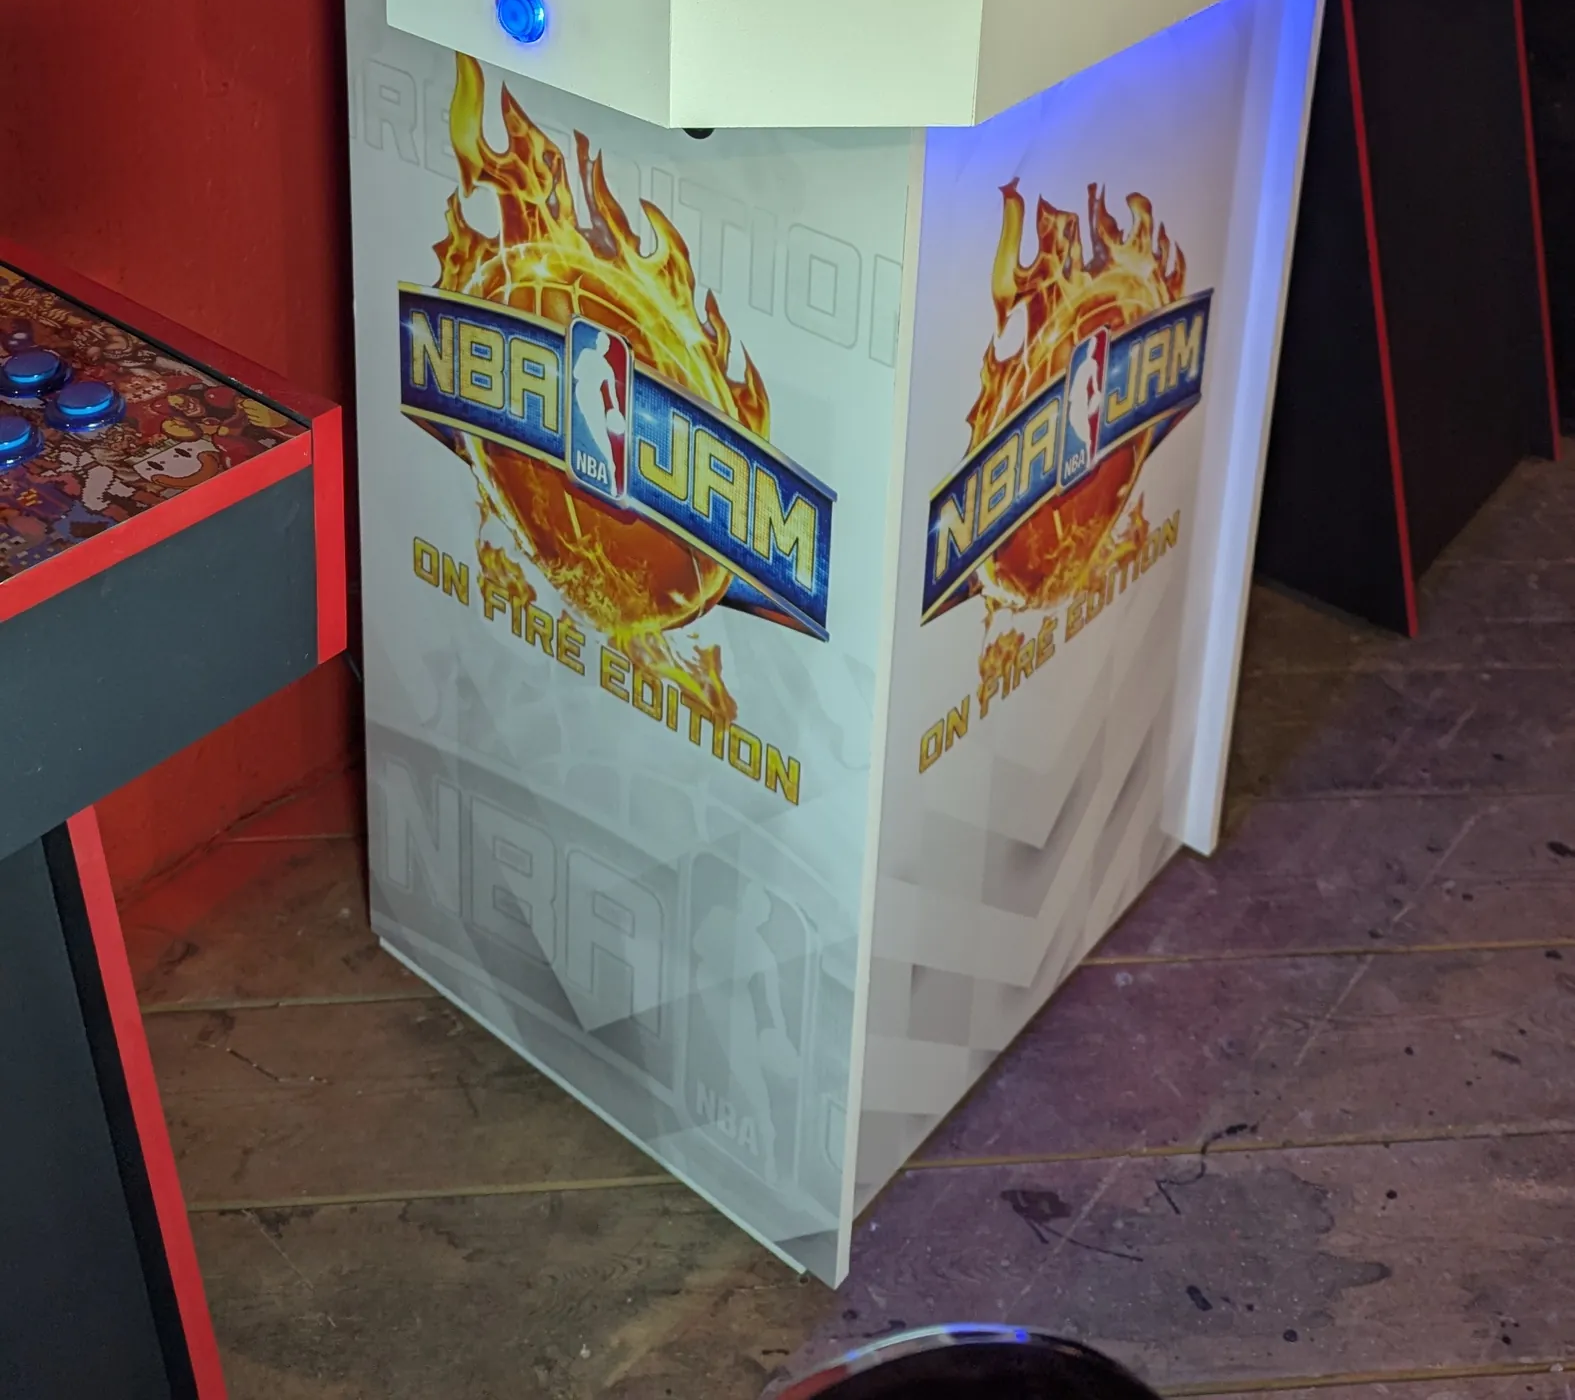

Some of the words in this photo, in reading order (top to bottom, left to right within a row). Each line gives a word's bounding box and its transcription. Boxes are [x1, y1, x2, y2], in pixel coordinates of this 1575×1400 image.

[409, 309, 562, 433] NBA
[637, 410, 819, 590] JAM
[575, 449, 609, 486] NBA
[934, 412, 1057, 580] NBA
[1106, 313, 1203, 424] JAM
[1063, 448, 1086, 479] NBA
[412, 536, 470, 607] ON
[482, 586, 586, 677] FIRE
[600, 645, 801, 806] EDITION
[918, 694, 970, 775] ON
[976, 623, 1057, 719] FIRE
[1065, 509, 1180, 646] EDITION
[695, 1081, 760, 1156] NBA
